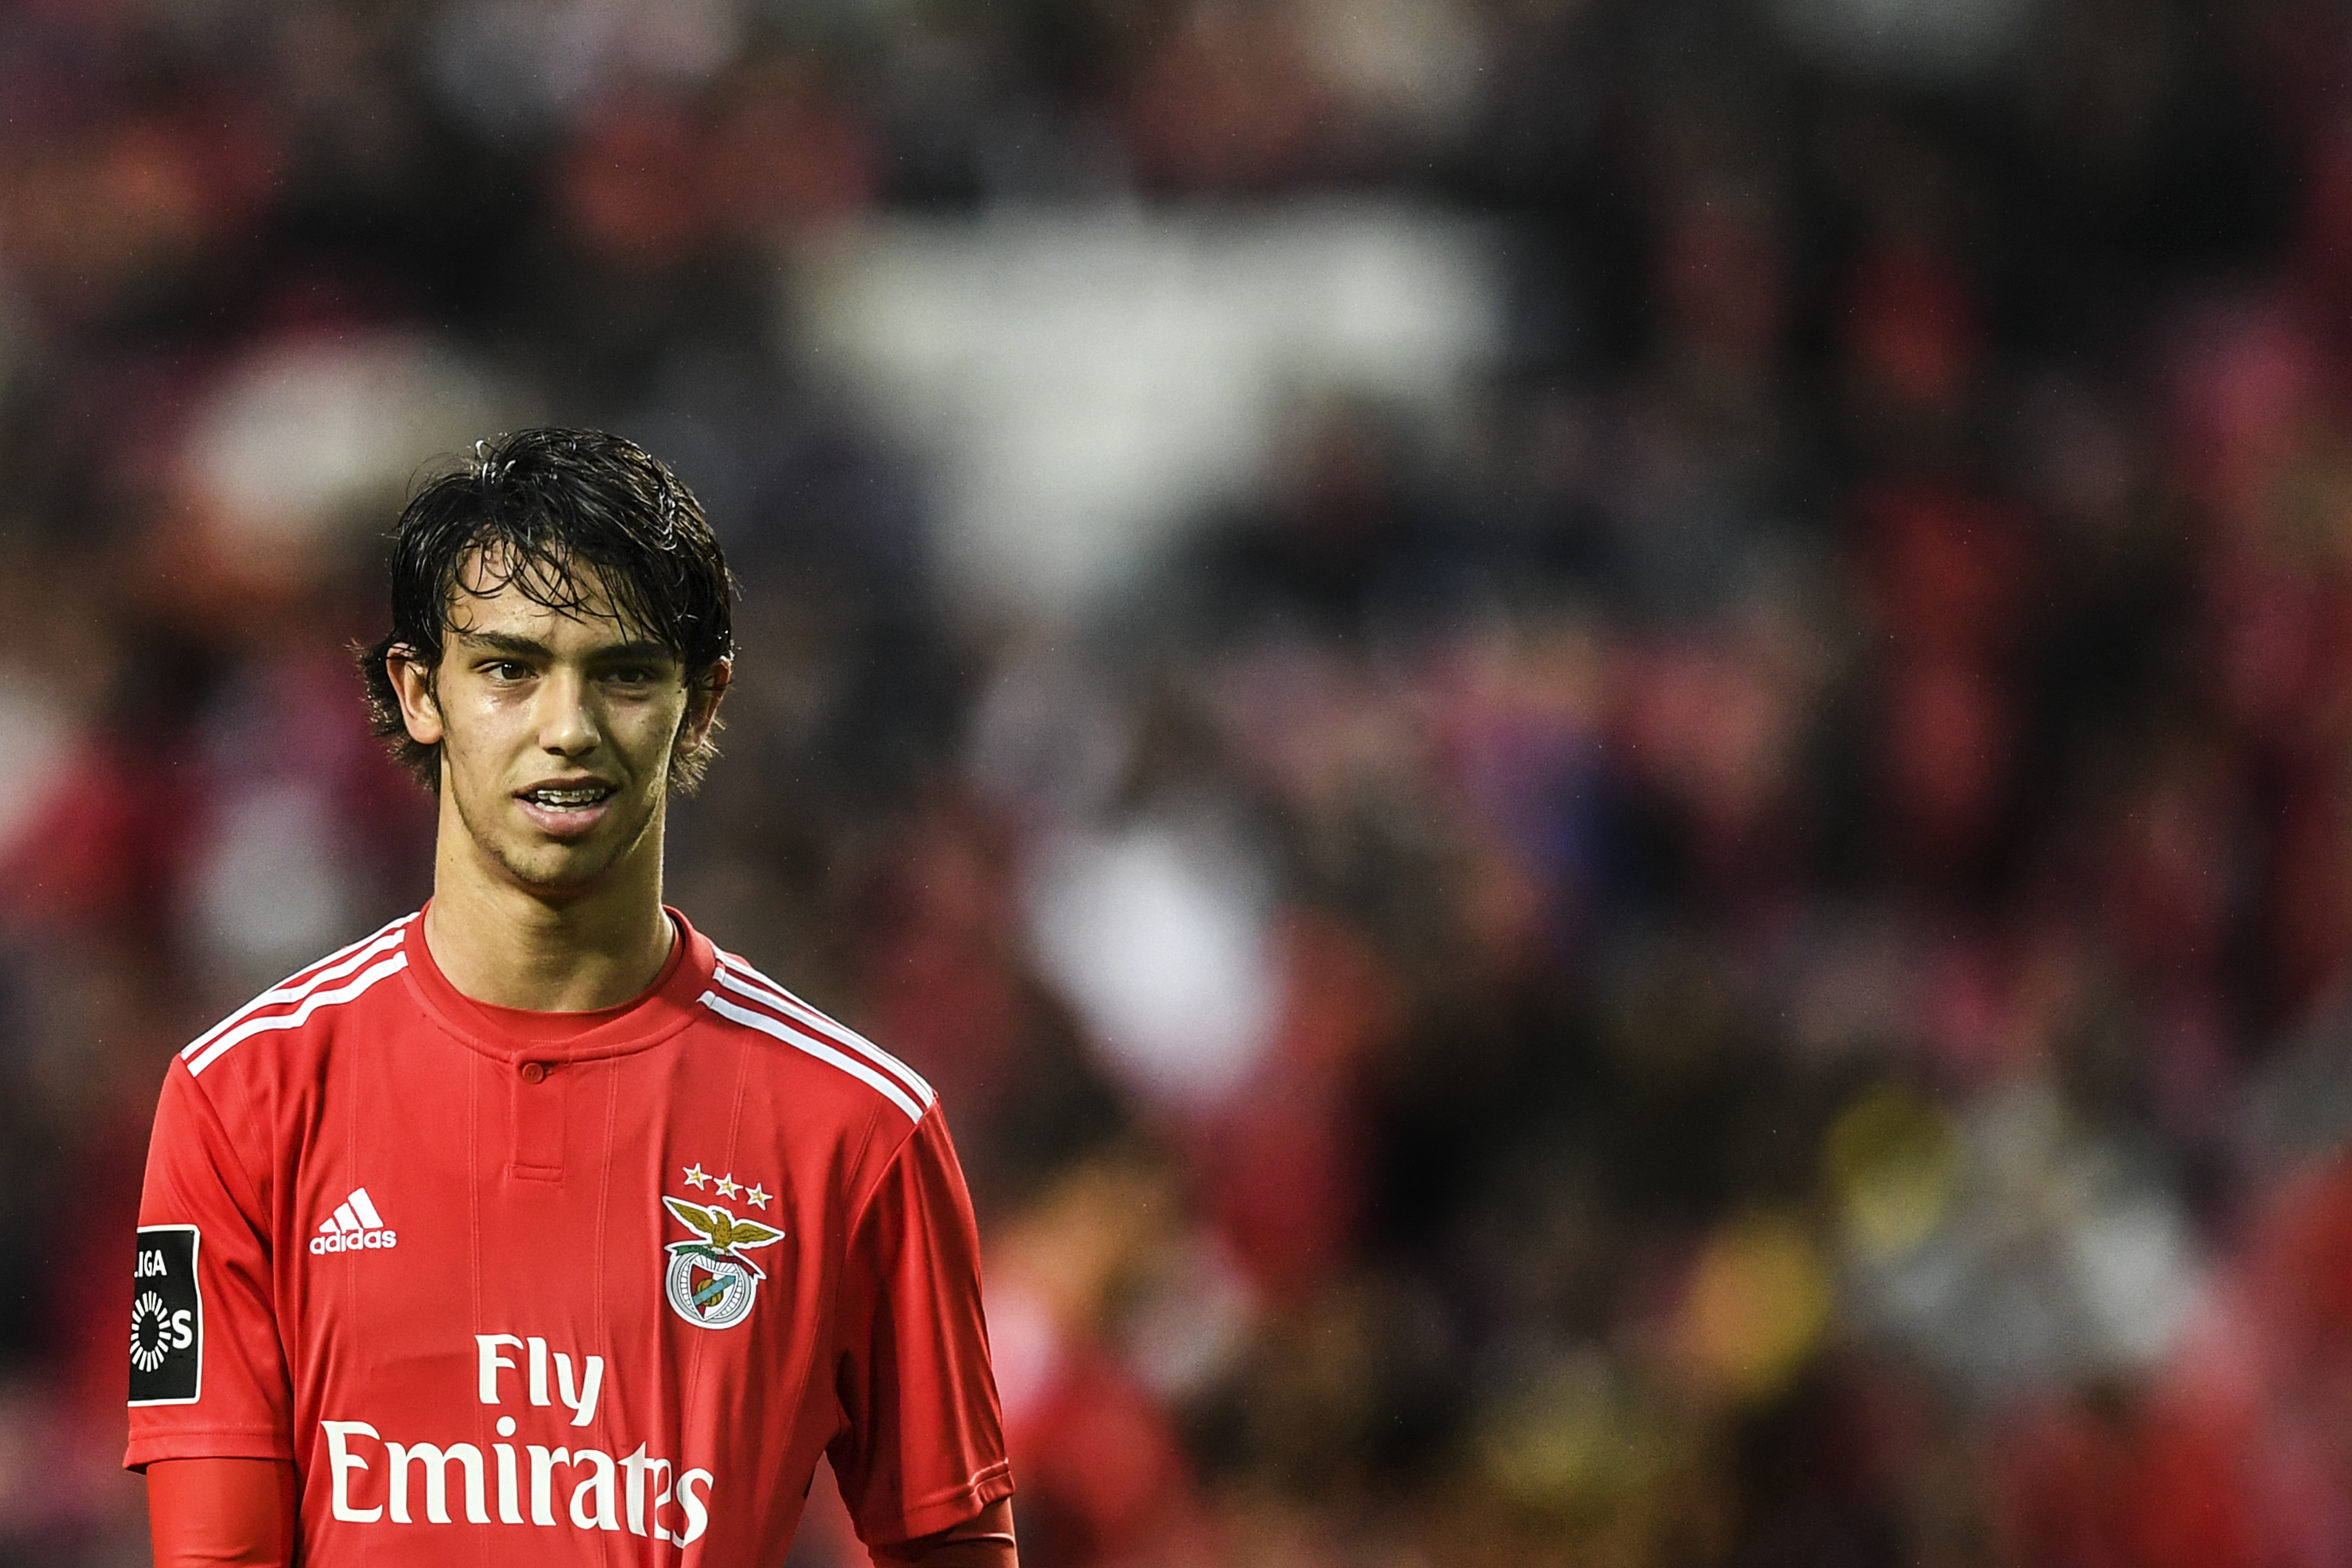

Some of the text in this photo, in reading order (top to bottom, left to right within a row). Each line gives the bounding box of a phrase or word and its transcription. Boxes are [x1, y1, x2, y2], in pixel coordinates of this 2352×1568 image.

[309, 1229, 397, 1255] adidas
[474, 1333, 604, 1427] Fly
[320, 1415, 714, 1549] Emirates
